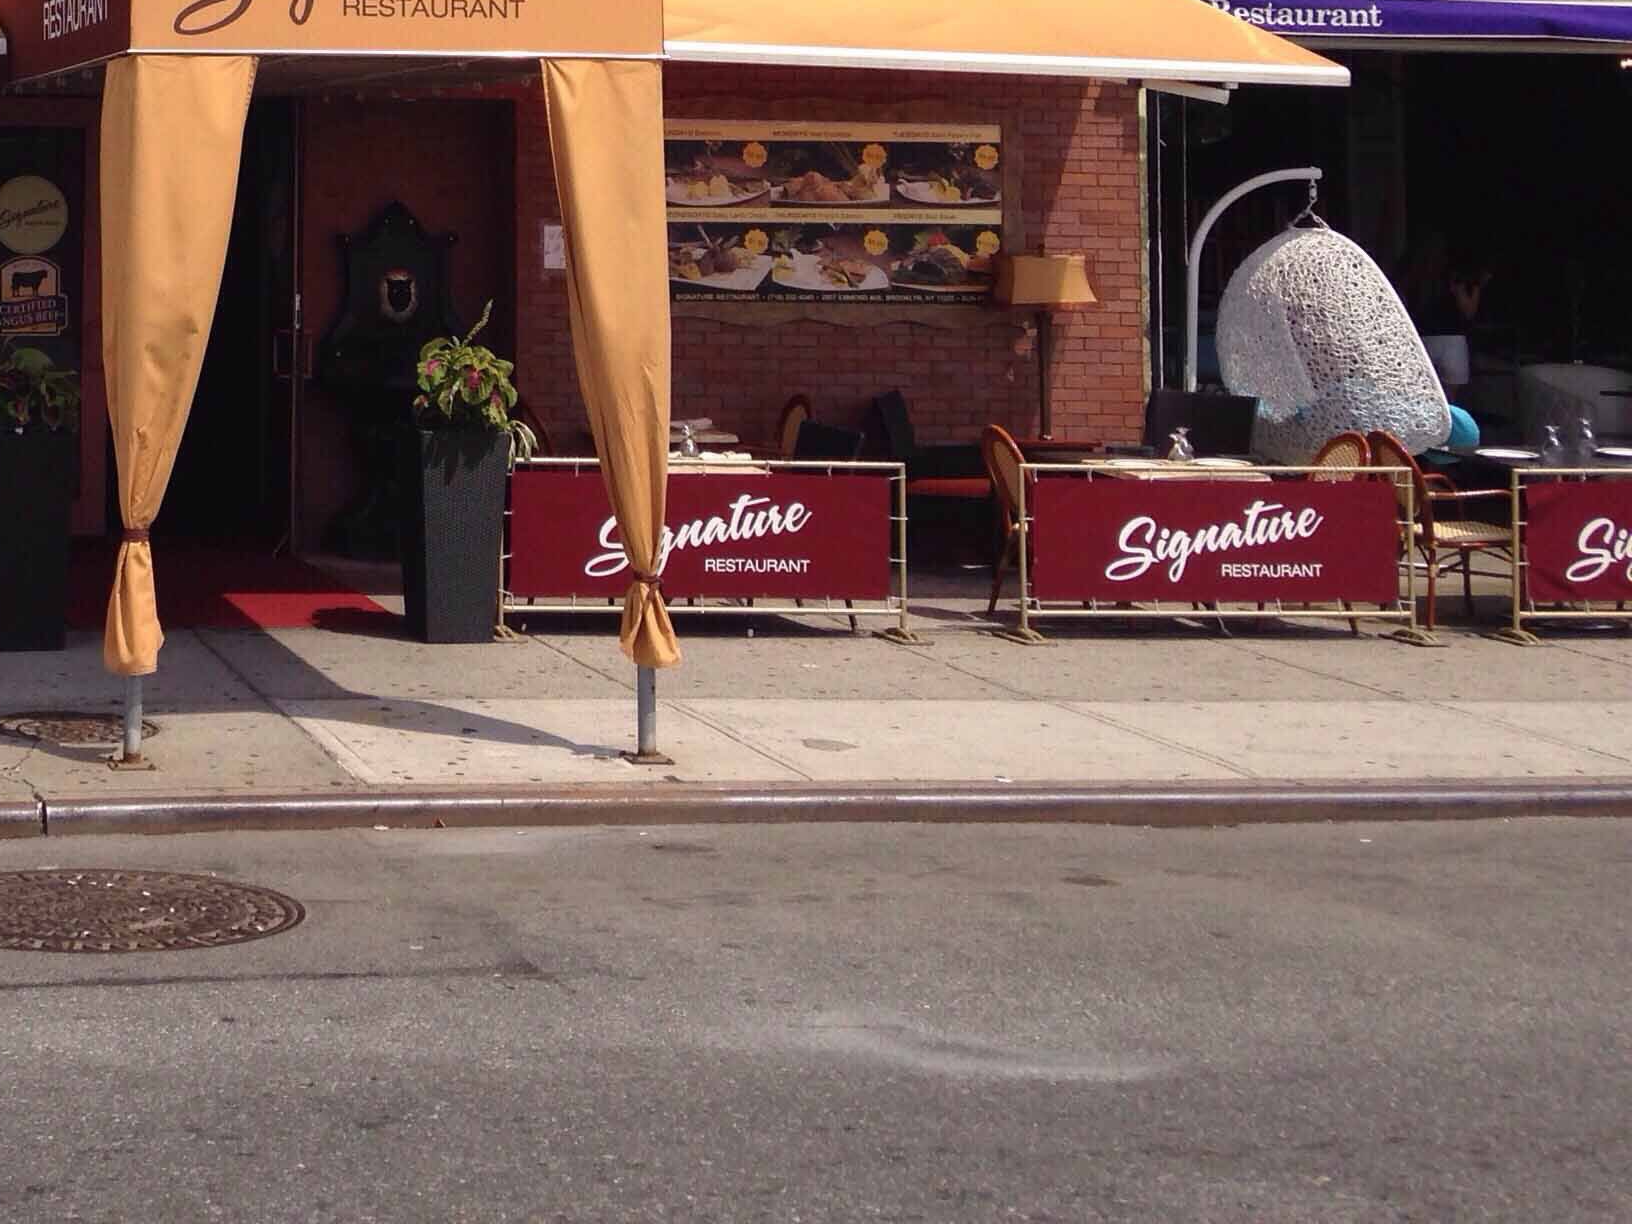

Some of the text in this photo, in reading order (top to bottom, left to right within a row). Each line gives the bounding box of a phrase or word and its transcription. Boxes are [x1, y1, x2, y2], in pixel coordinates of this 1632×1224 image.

[584, 493, 812, 577] Sgnature
[1105, 500, 1324, 583] Signature
[704, 558, 811, 574] RESTAURANT
[1221, 563, 1323, 578] RESTAURANT
